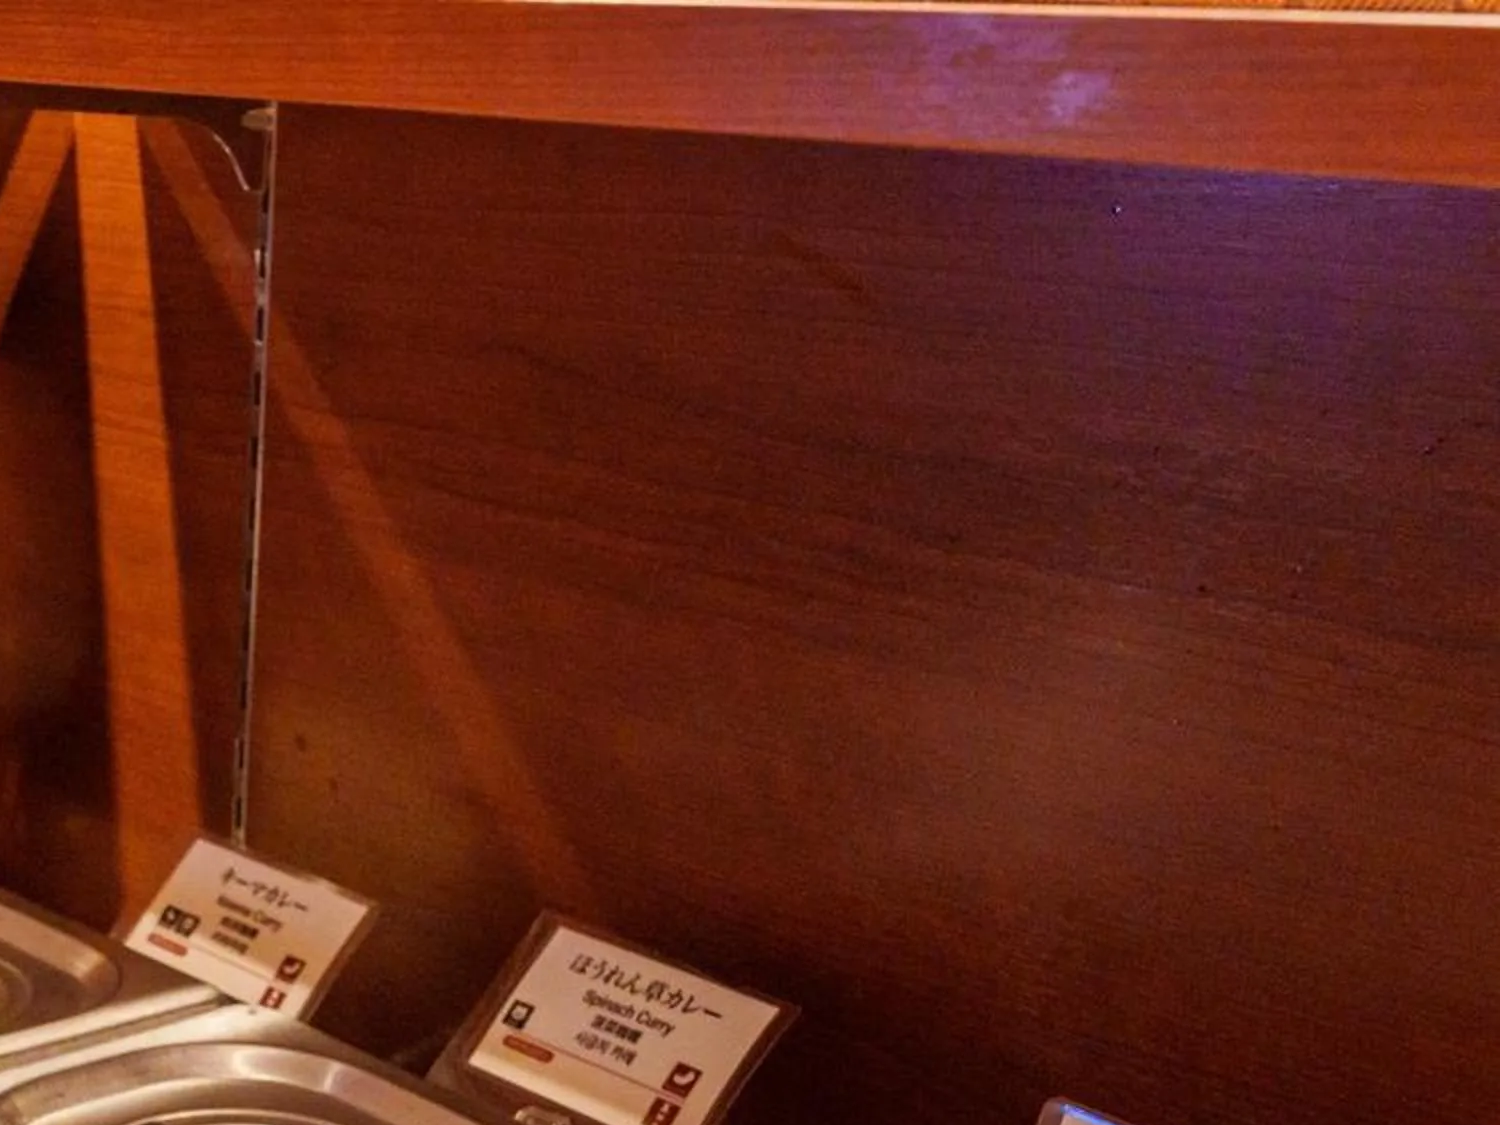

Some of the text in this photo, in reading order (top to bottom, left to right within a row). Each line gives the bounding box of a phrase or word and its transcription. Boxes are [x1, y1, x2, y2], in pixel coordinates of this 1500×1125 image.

[568, 953, 723, 1019] ほうれん草カレー
[635, 1009, 676, 1039] Curry
